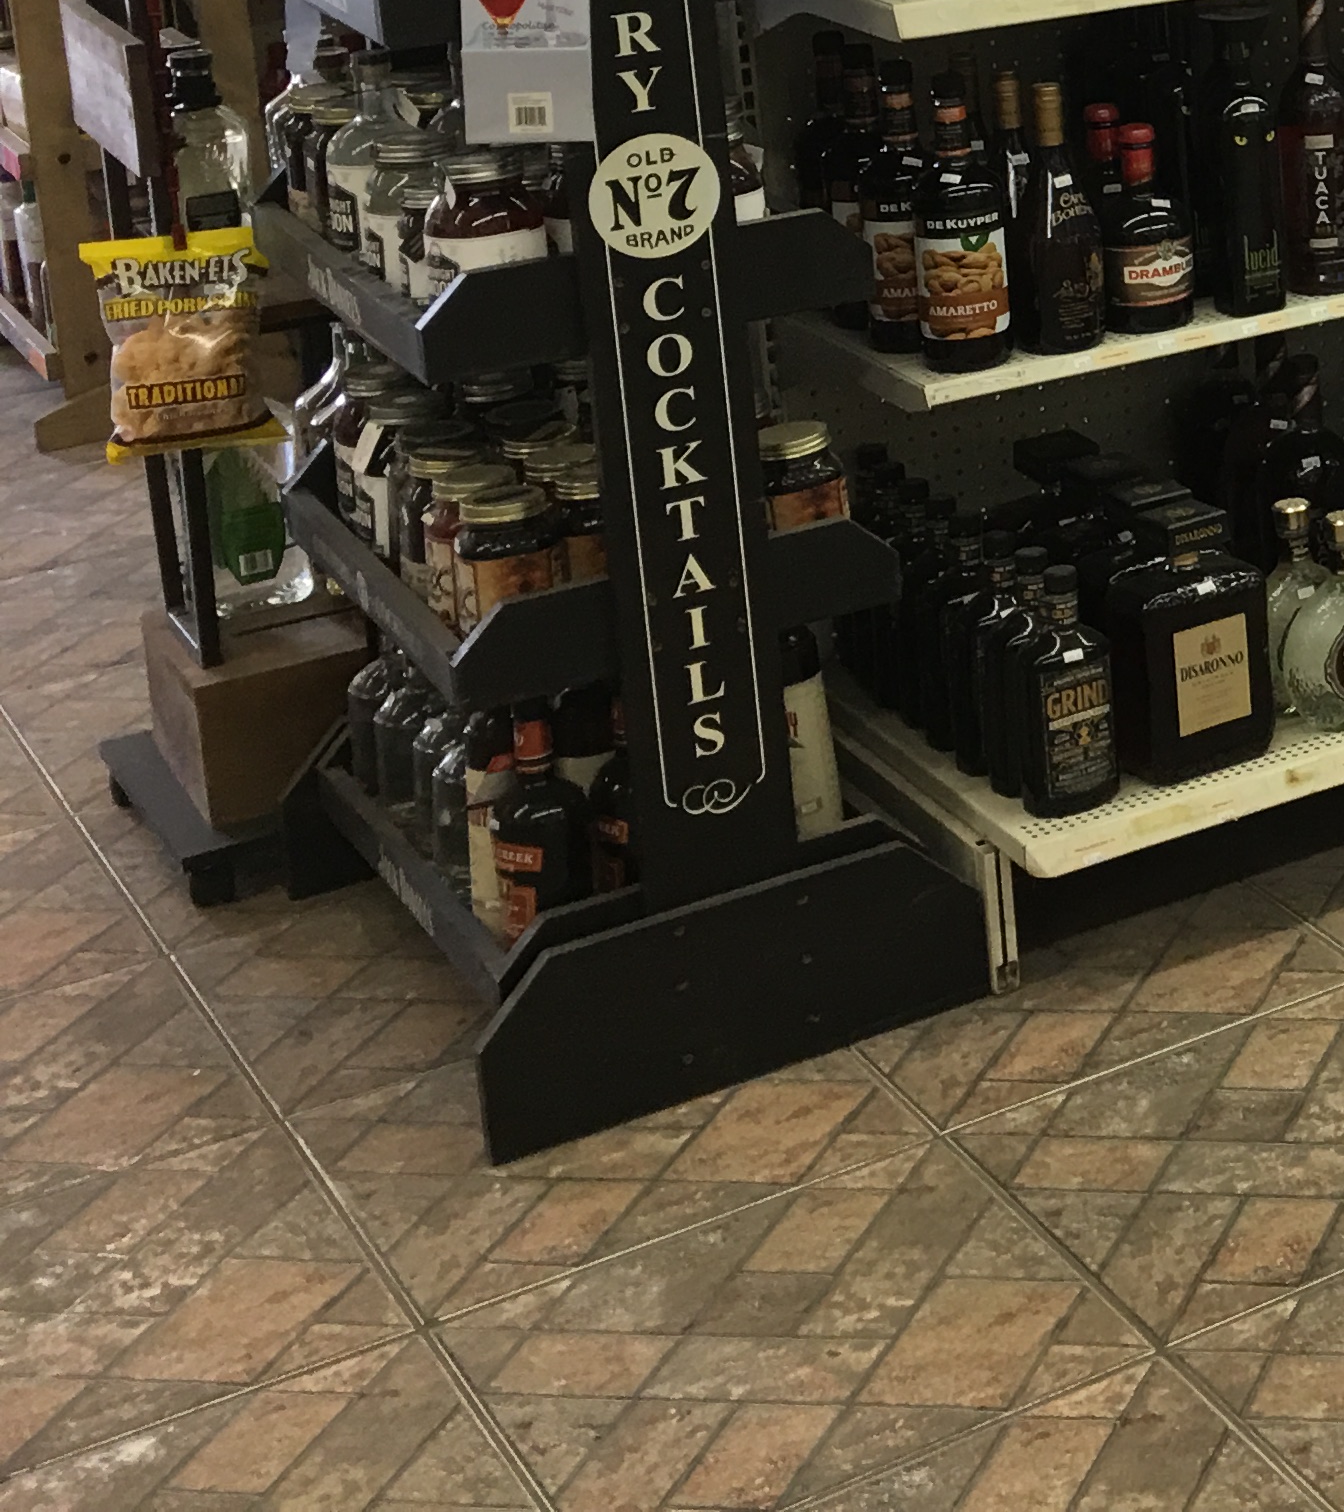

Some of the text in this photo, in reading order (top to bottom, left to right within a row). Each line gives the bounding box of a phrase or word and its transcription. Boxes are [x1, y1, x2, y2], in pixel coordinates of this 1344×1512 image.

[626, 147, 676, 169] OLD
[1313, 151, 1331, 226] TUACA
[625, 224, 695, 250] BRAND
[1243, 229, 1280, 272] lucid
[105, 299, 154, 322] FRIED
[928, 299, 998, 318] AMARETTO
[642, 274, 725, 759] COCKTAILS
[1174, 523, 1223, 546] DISARONNO
[1180, 650, 1244, 683] DISARONNO
[1046, 677, 1110, 718] GRIND
